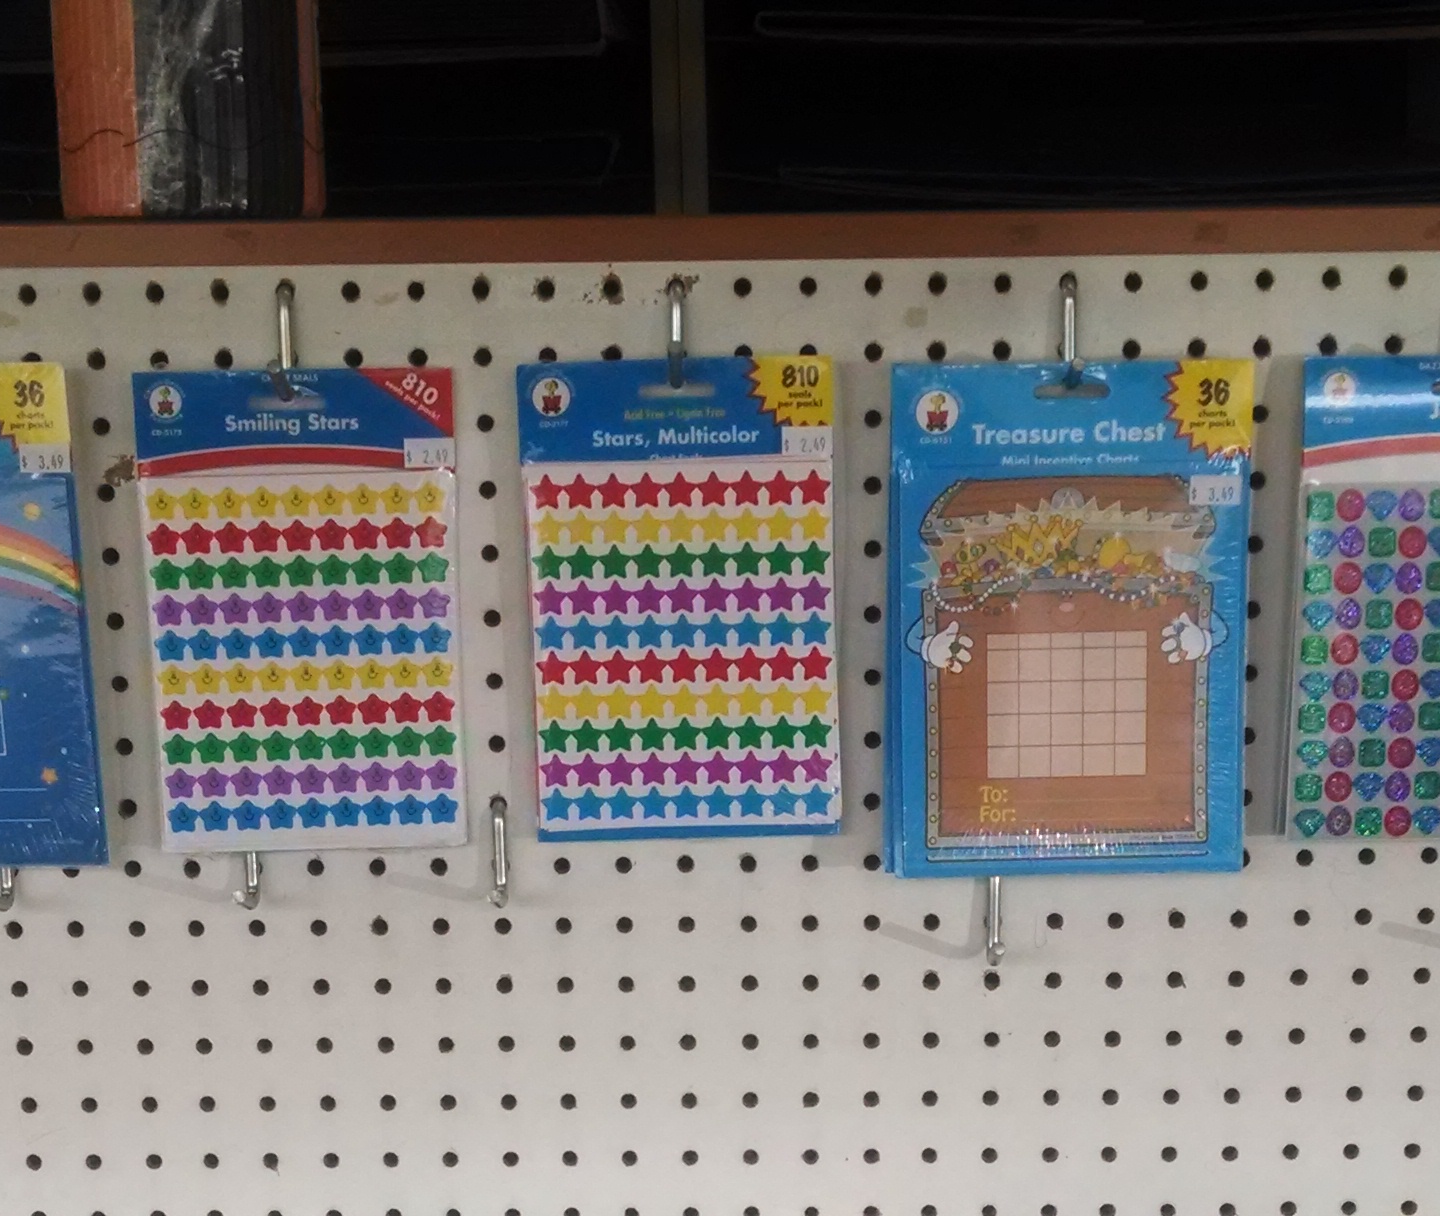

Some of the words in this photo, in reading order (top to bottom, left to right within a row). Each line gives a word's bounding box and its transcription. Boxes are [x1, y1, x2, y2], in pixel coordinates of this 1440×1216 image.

[780, 364, 820, 390] 810
[13, 379, 46, 409] 36
[401, 371, 440, 406] 810
[1196, 377, 1230, 407] 36
[225, 412, 301, 436] Smiling
[307, 412, 360, 432] Stars
[971, 422, 1086, 445] Treasure
[1093, 418, 1167, 444] Chest
[592, 429, 651, 449] Stars,
[656, 425, 760, 446] Multicolor
[799, 436, 826, 453] 2.49
[38, 454, 65, 471] 3.49
[423, 449, 449, 465] 2.49
[1000, 455, 1031, 467] Mini
[1033, 455, 1094, 467] Incentive
[1096, 453, 1141, 466] Charts
[1208, 486, 1234, 503] 3.49
[978, 785, 1009, 803] To:
[978, 806, 1017, 824] For:
